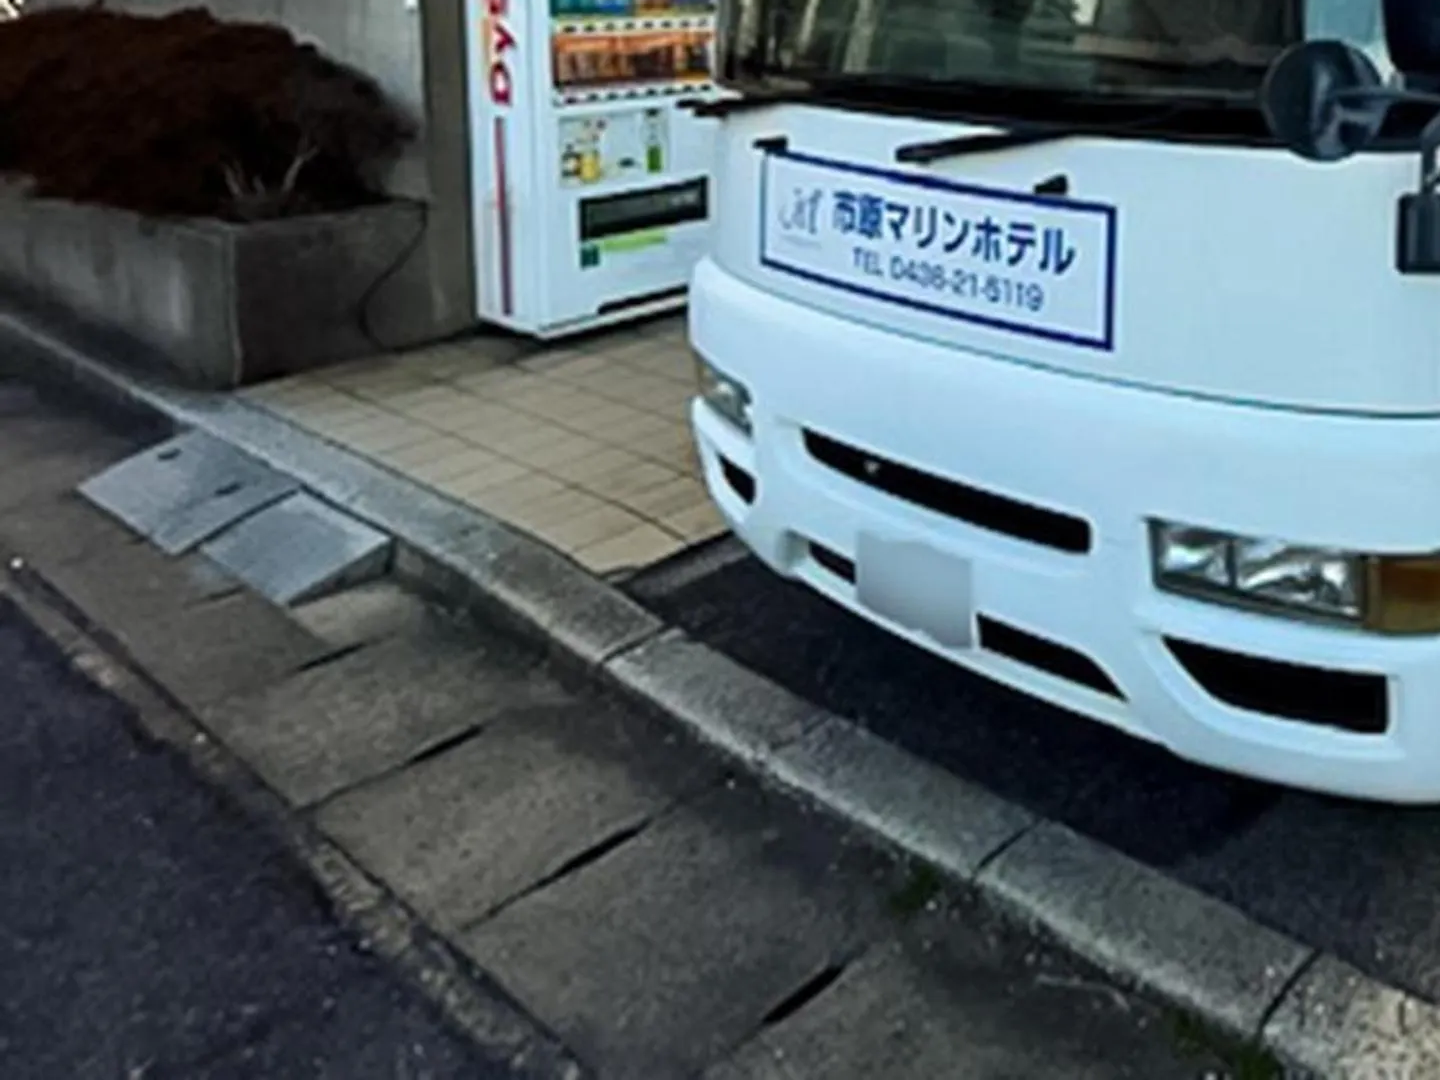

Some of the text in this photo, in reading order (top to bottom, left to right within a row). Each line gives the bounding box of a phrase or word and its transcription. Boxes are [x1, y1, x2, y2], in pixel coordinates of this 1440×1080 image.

[832, 190, 1076, 275] 市原マリンホテル
[852, 246, 884, 278] TEL
